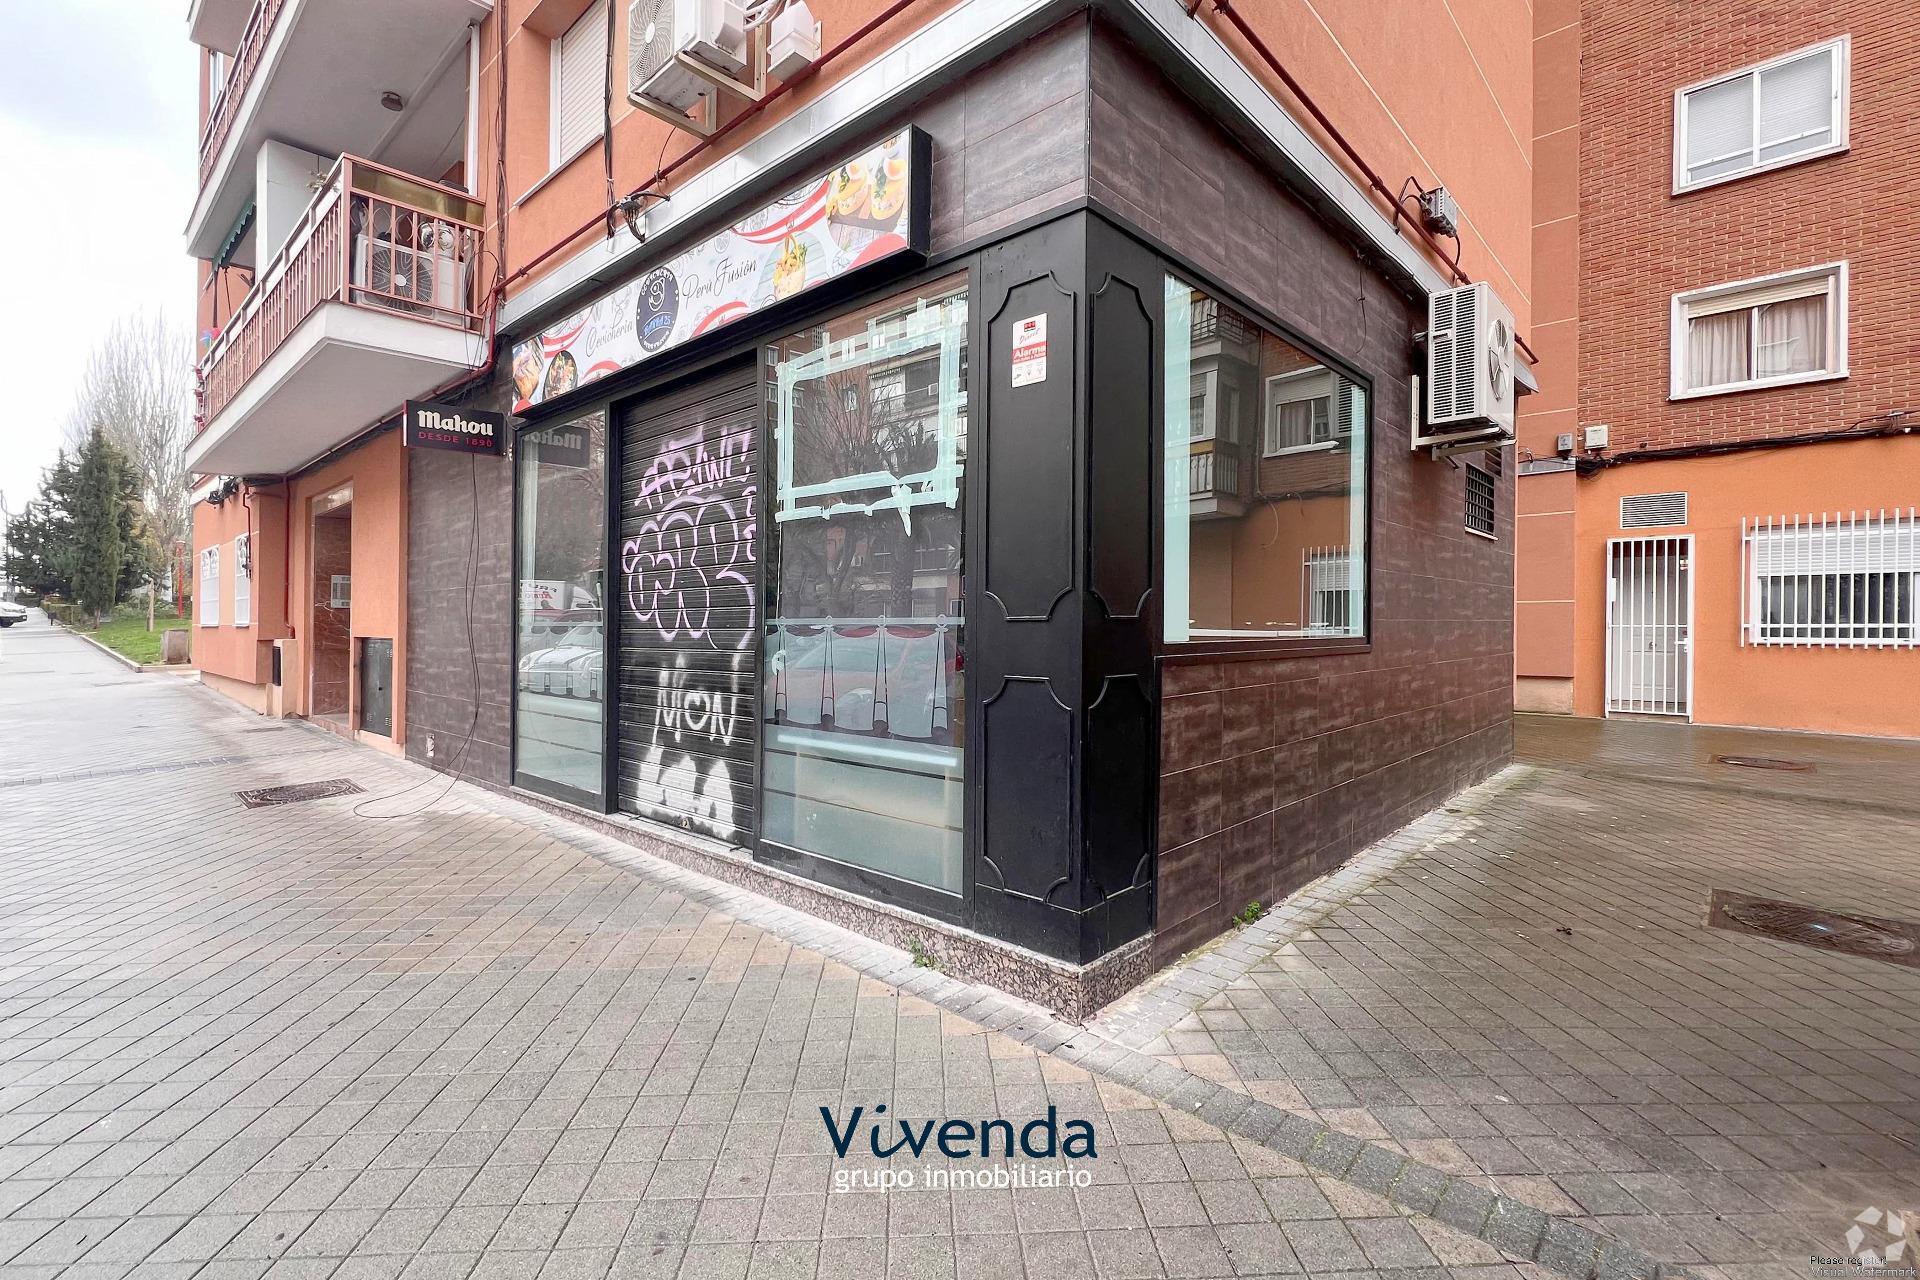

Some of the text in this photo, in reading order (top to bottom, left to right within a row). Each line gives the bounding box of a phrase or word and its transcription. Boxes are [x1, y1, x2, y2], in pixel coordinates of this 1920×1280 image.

[714, 257, 756, 296] Fusión
[417, 410, 494, 436] Mahou
[419, 431, 493, 448] DESDE 1890
